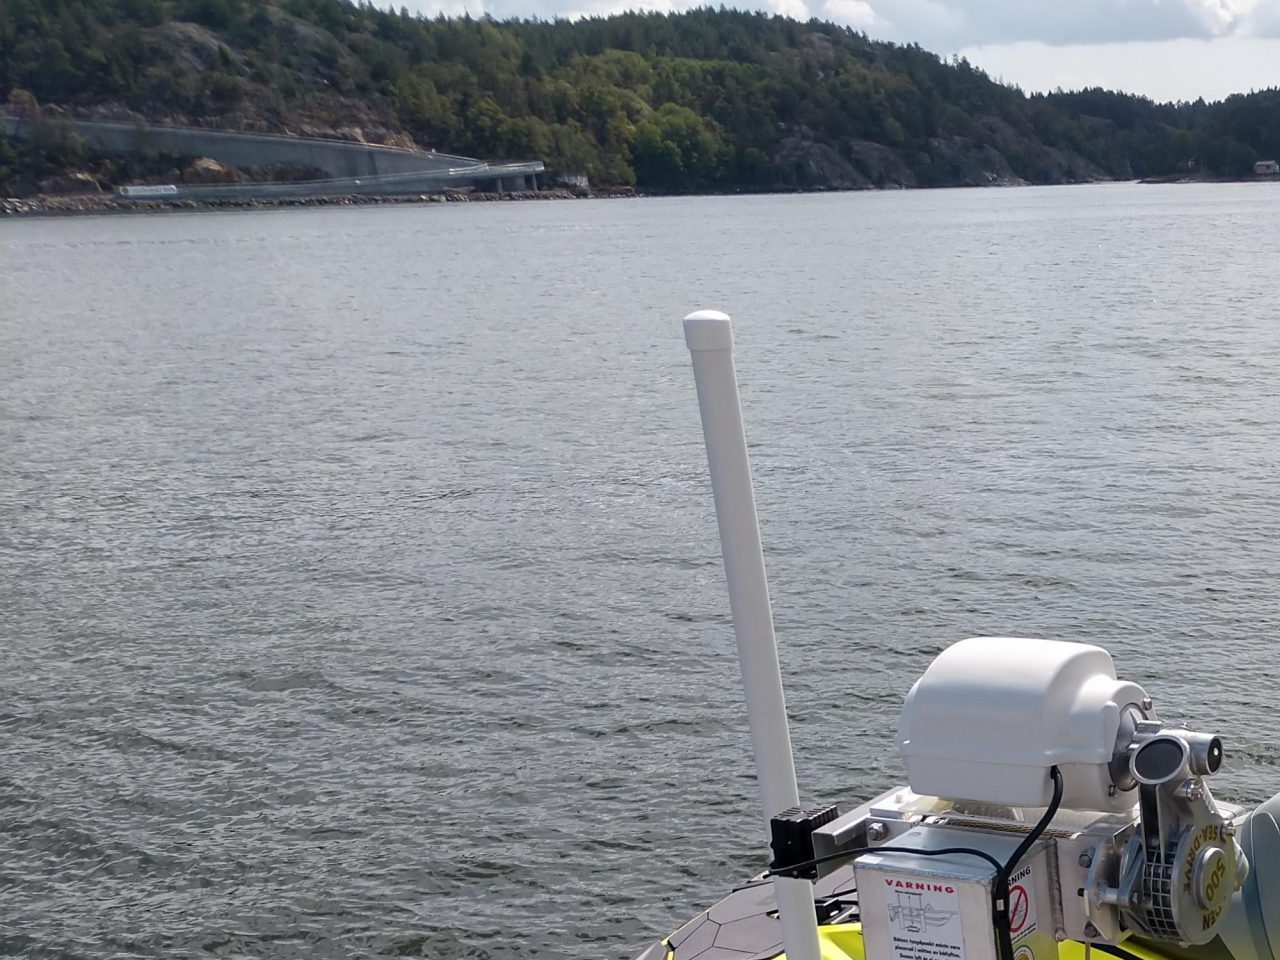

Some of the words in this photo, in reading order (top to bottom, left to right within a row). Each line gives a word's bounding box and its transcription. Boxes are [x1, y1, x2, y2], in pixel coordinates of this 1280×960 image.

[884, 879, 955, 894] VARNING
[1007, 865, 1031, 887] RNING
[1205, 857, 1226, 902] 500
